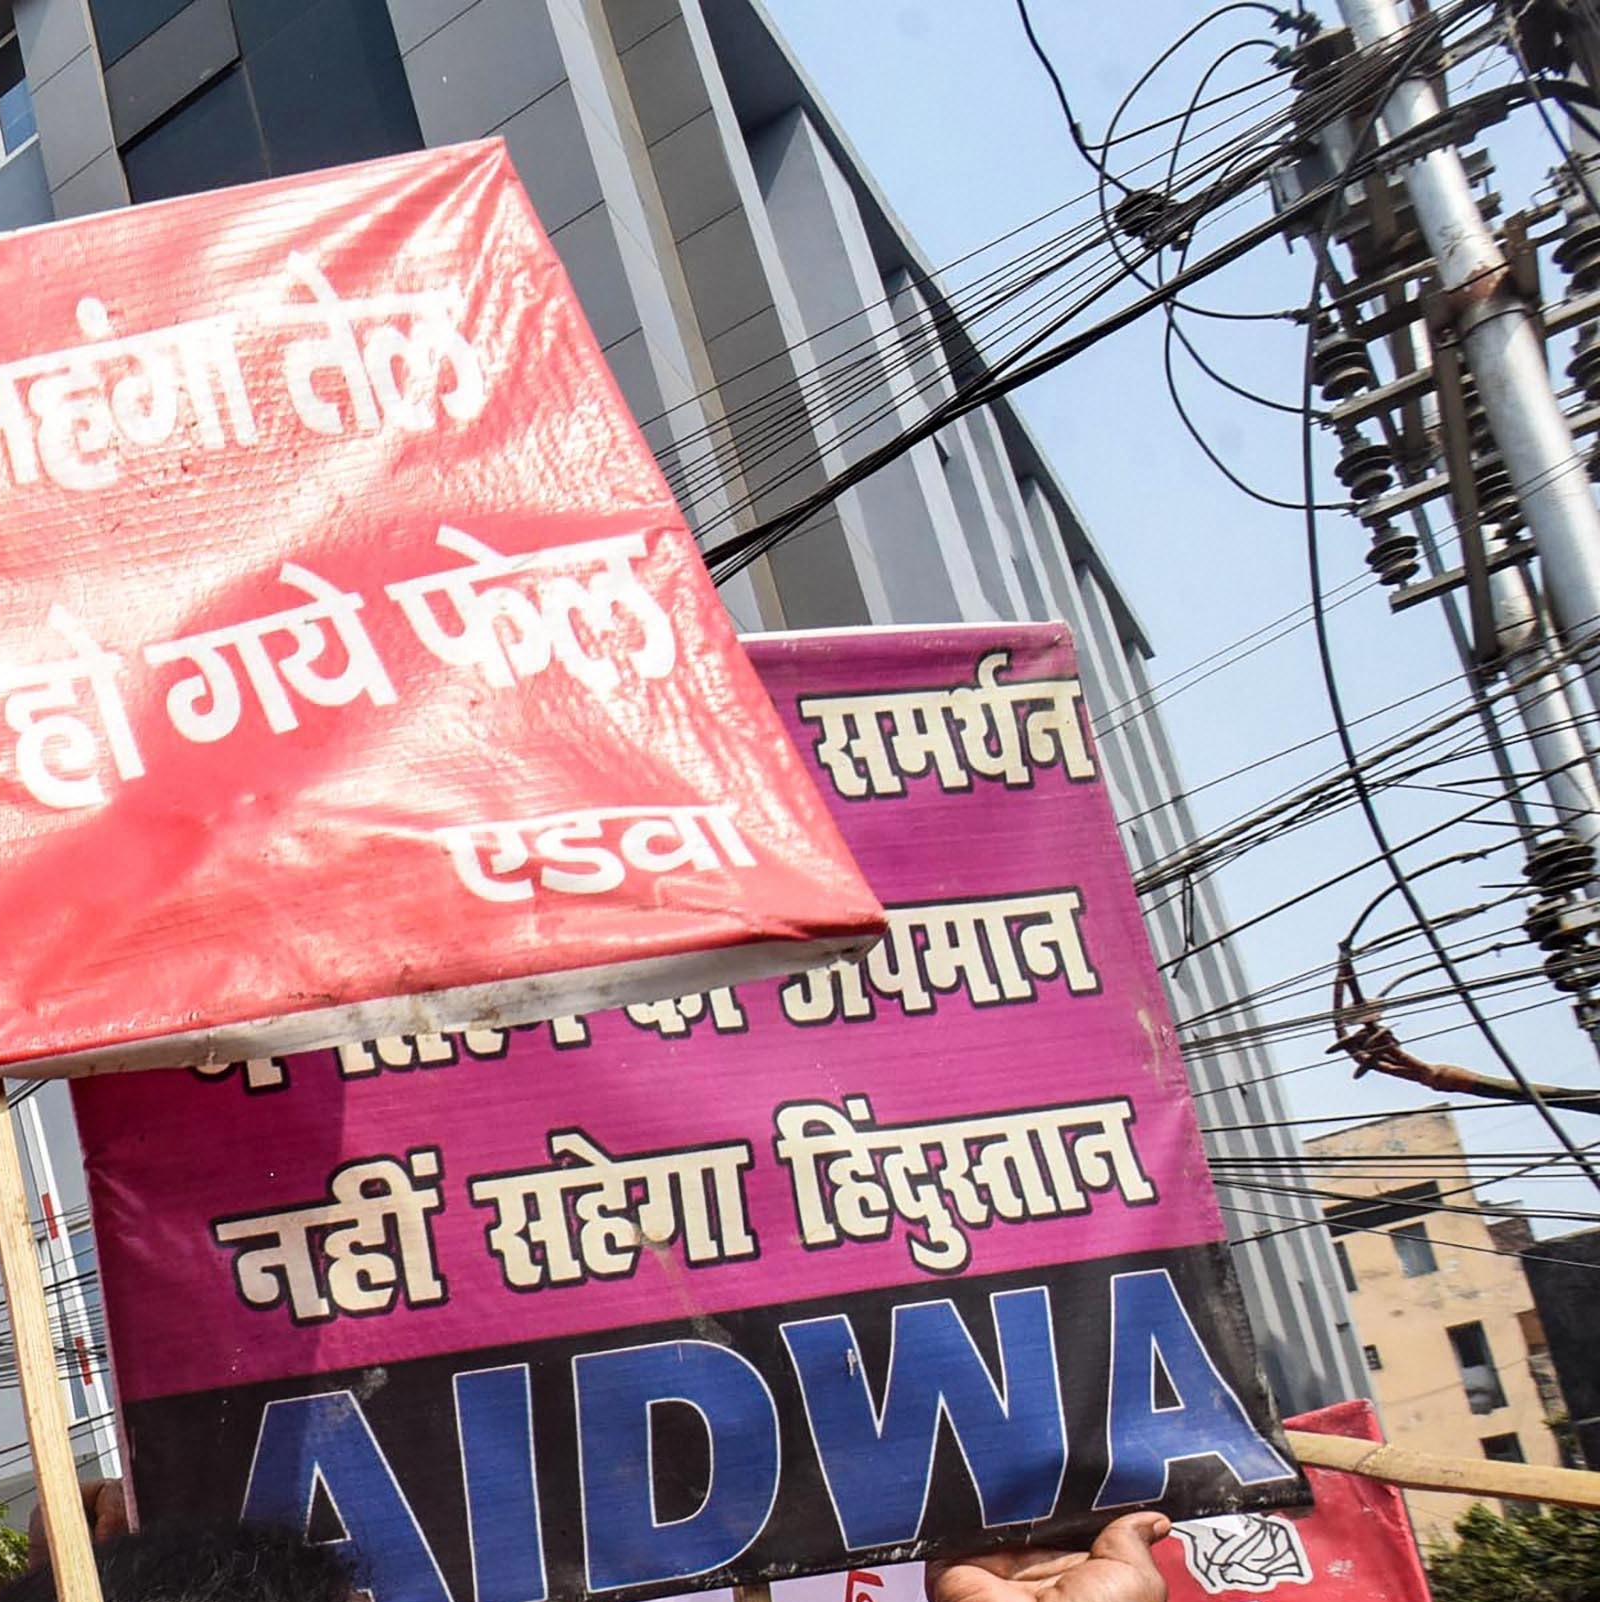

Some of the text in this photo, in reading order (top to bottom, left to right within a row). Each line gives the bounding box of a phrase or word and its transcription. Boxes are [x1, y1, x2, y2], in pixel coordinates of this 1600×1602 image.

[260, 250, 486, 436] तेल
[145, 562, 398, 744] गये
[385, 524, 678, 697] फेल
[800, 653, 1096, 797] समर्थन
[430, 803, 756, 901] एडवा
[218, 1094, 1153, 1325] नहीं सहेगा हिंदुस्तान
